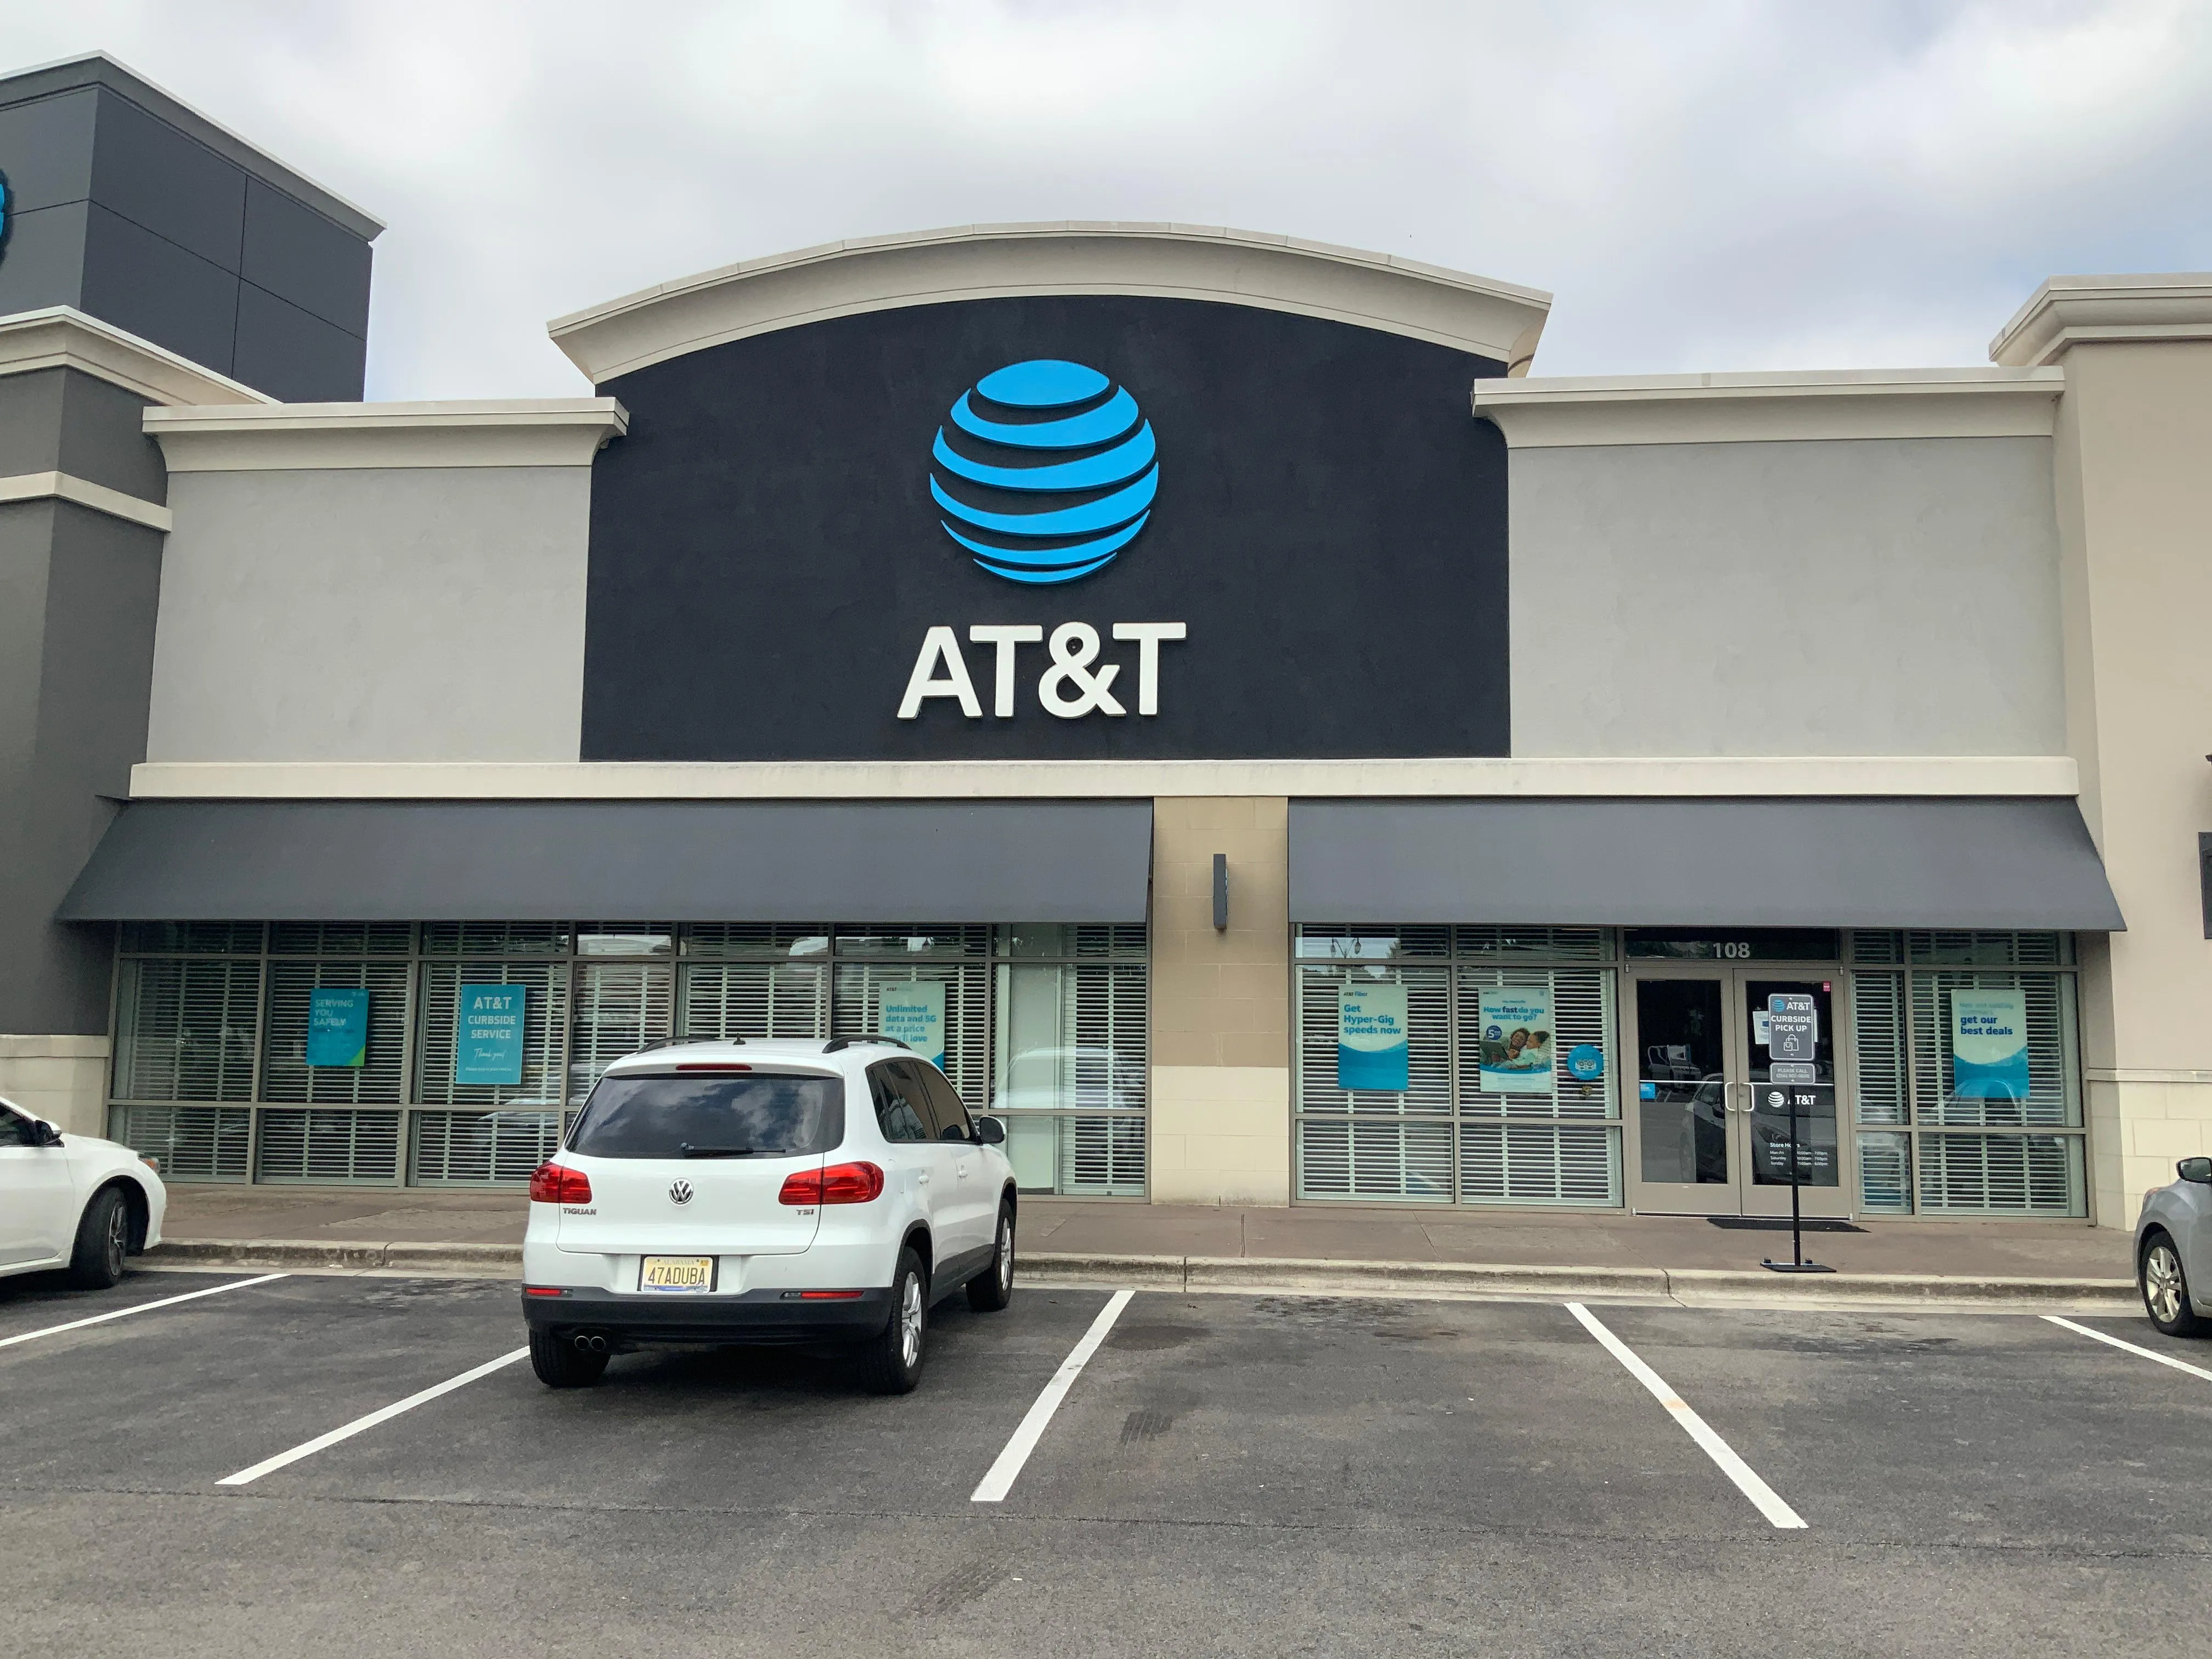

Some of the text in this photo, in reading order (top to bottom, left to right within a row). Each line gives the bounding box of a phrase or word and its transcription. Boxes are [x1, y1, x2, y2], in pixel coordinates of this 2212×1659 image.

[897, 622, 1187, 719] AT&T
[1713, 942, 1750, 958] 108
[315, 999, 353, 1007] SERVING
[474, 996, 512, 1009] AT&T
[1786, 1002, 1810, 1011] AT&T
[1344, 1004, 1361, 1012] Get
[468, 1015, 516, 1025] CURBSIDE
[1344, 1014, 1394, 1025] Hyper-Gig
[1960, 1016, 1978, 1025] get
[904, 1025, 925, 1033] price
[1344, 1025, 1378, 1035] speeds
[1961, 1026, 2013, 1035] best deals
[471, 1030, 511, 1039] SERVICE
[910, 1034, 928, 1042] love
[648, 1267, 705, 1284] 47ADUBA
